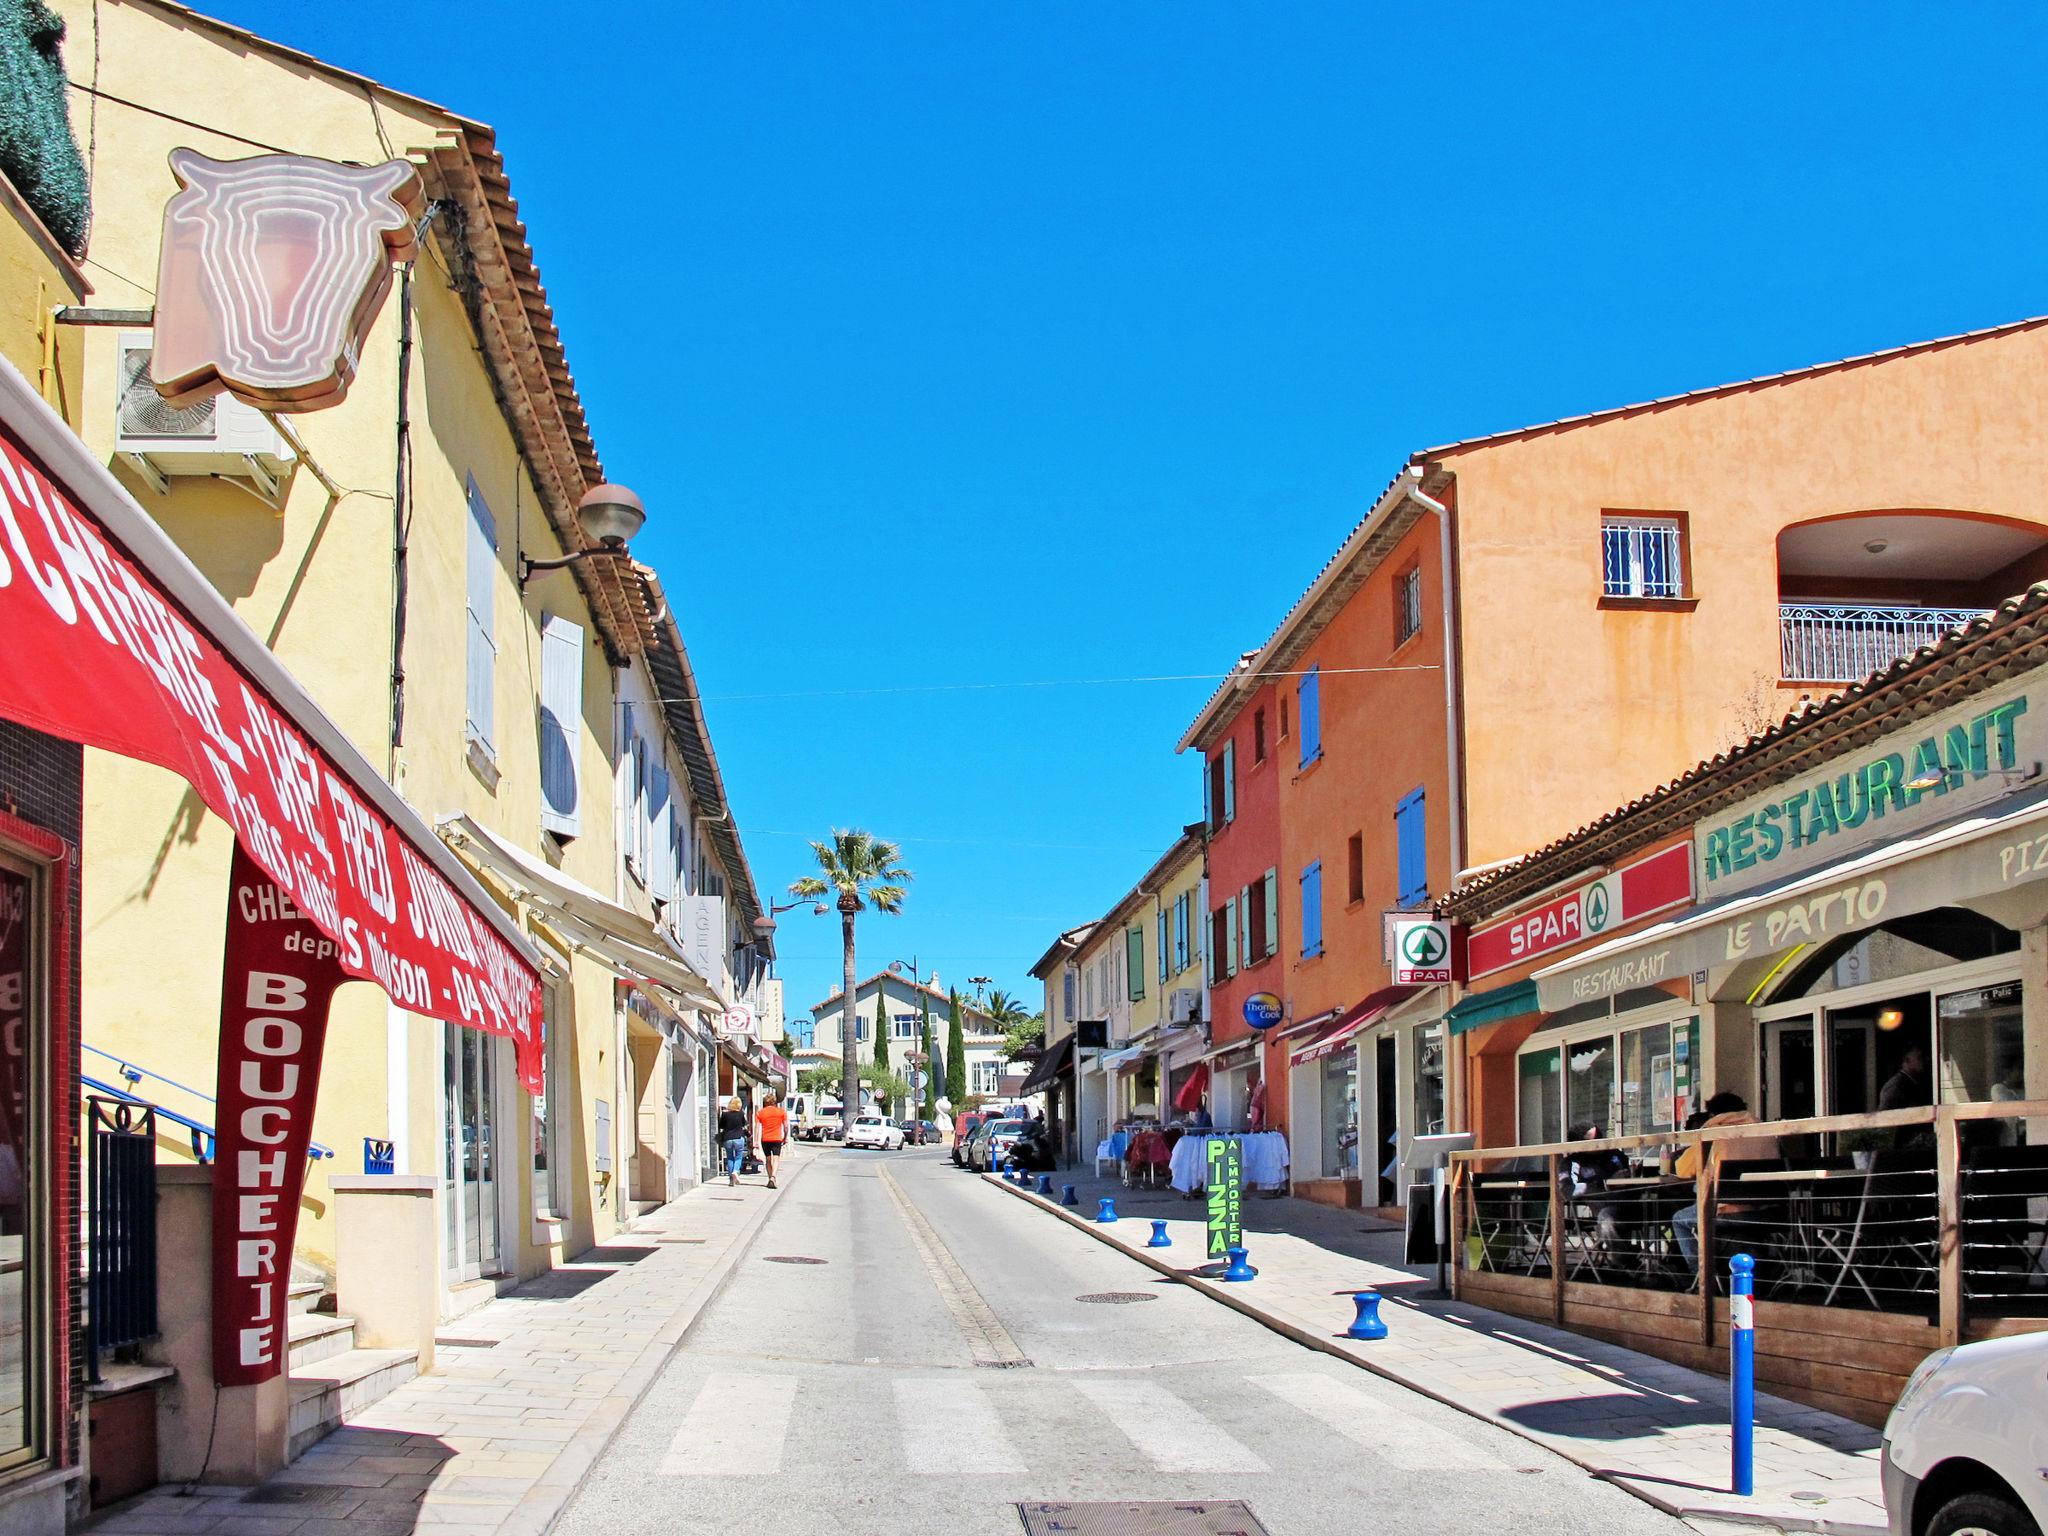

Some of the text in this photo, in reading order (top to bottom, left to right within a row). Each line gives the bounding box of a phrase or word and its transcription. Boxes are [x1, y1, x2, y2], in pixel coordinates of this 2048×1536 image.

[0, 440, 249, 766] CHERIE
[324, 771, 397, 924] FRED
[1704, 694, 2028, 882] RESTAURANT
[201, 740, 294, 892] Plats
[451, 965, 486, 1025] 04
[1510, 901, 1579, 956] SPAR
[1725, 879, 1888, 960] LE PATIO
[1246, 1003, 1281, 1012] Thomas
[1259, 1010, 1281, 1019] Cook
[1399, 970, 1449, 982] SPAR
[1572, 950, 1670, 999] RESTAURANT
[237, 970, 307, 1367] BOUCHERIE
[1207, 1140, 1227, 1254] PIZZA
[1228, 1139, 1240, 1243] A EMPORTER
